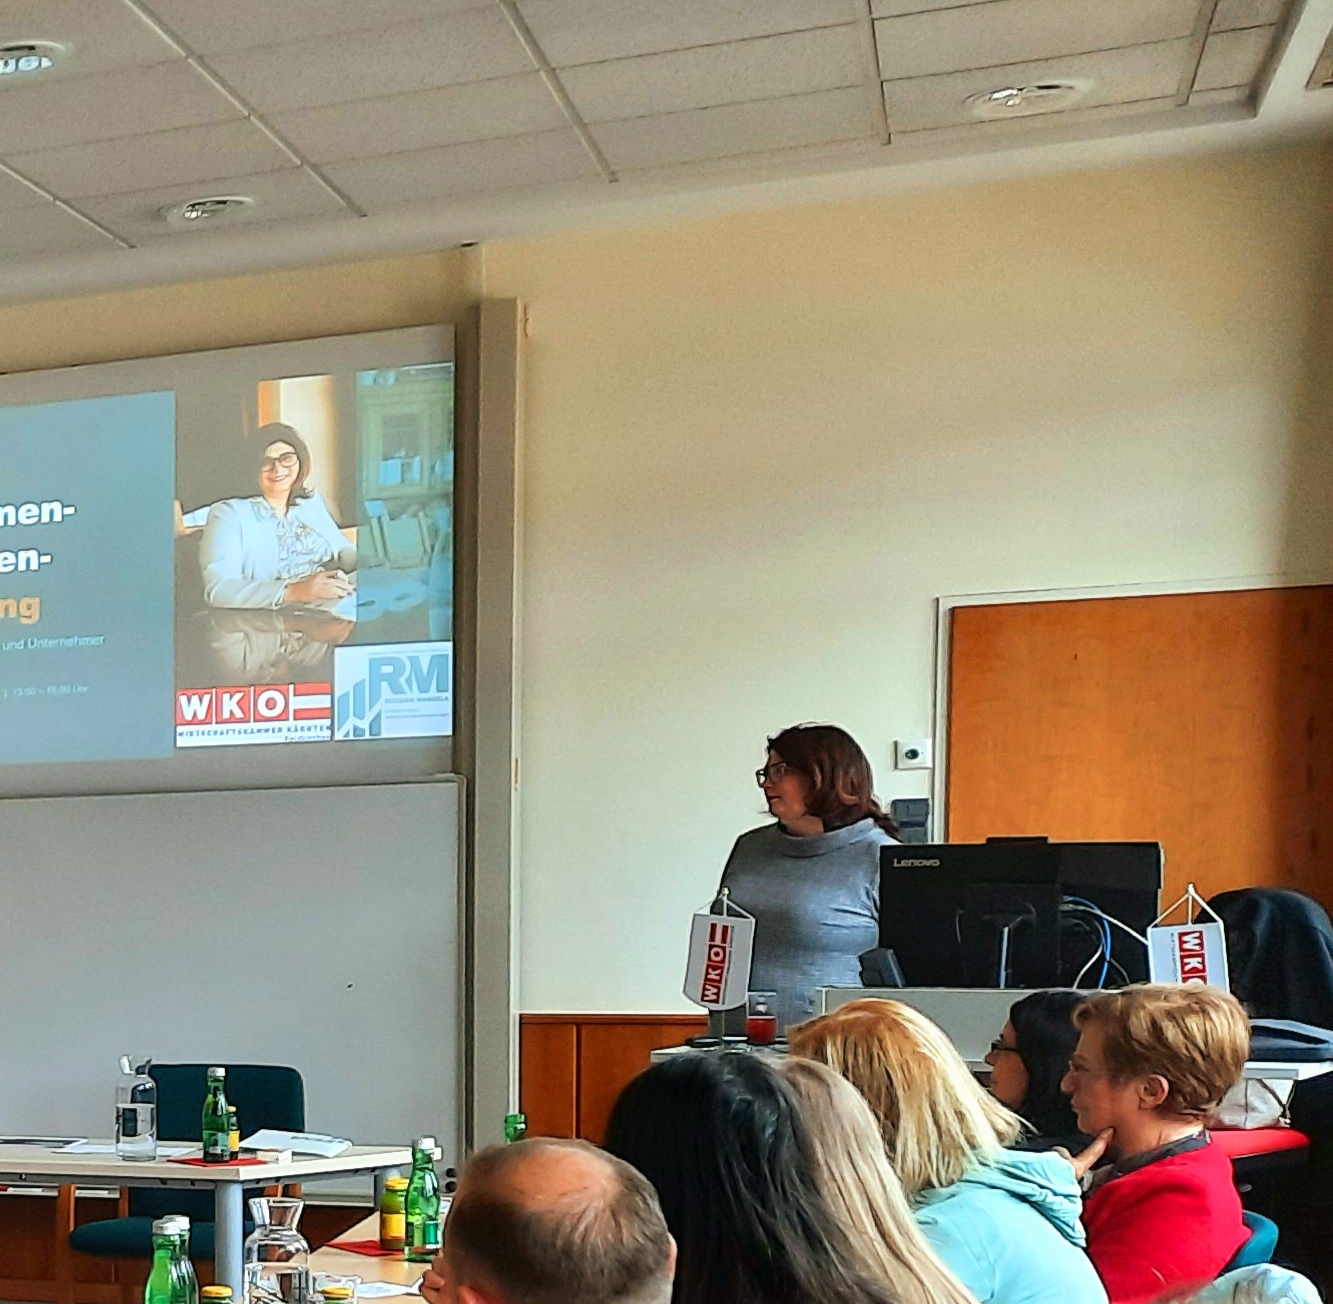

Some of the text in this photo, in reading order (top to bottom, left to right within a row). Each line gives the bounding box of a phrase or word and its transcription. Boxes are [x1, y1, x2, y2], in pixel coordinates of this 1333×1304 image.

[3, 638, 24, 650] und
[28, 634, 105, 650] Unternehmer
[369, 654, 450, 696] RM
[179, 689, 286, 721] WKO
[893, 857, 941, 868] Lenovo
[703, 946, 725, 1001] WKO
